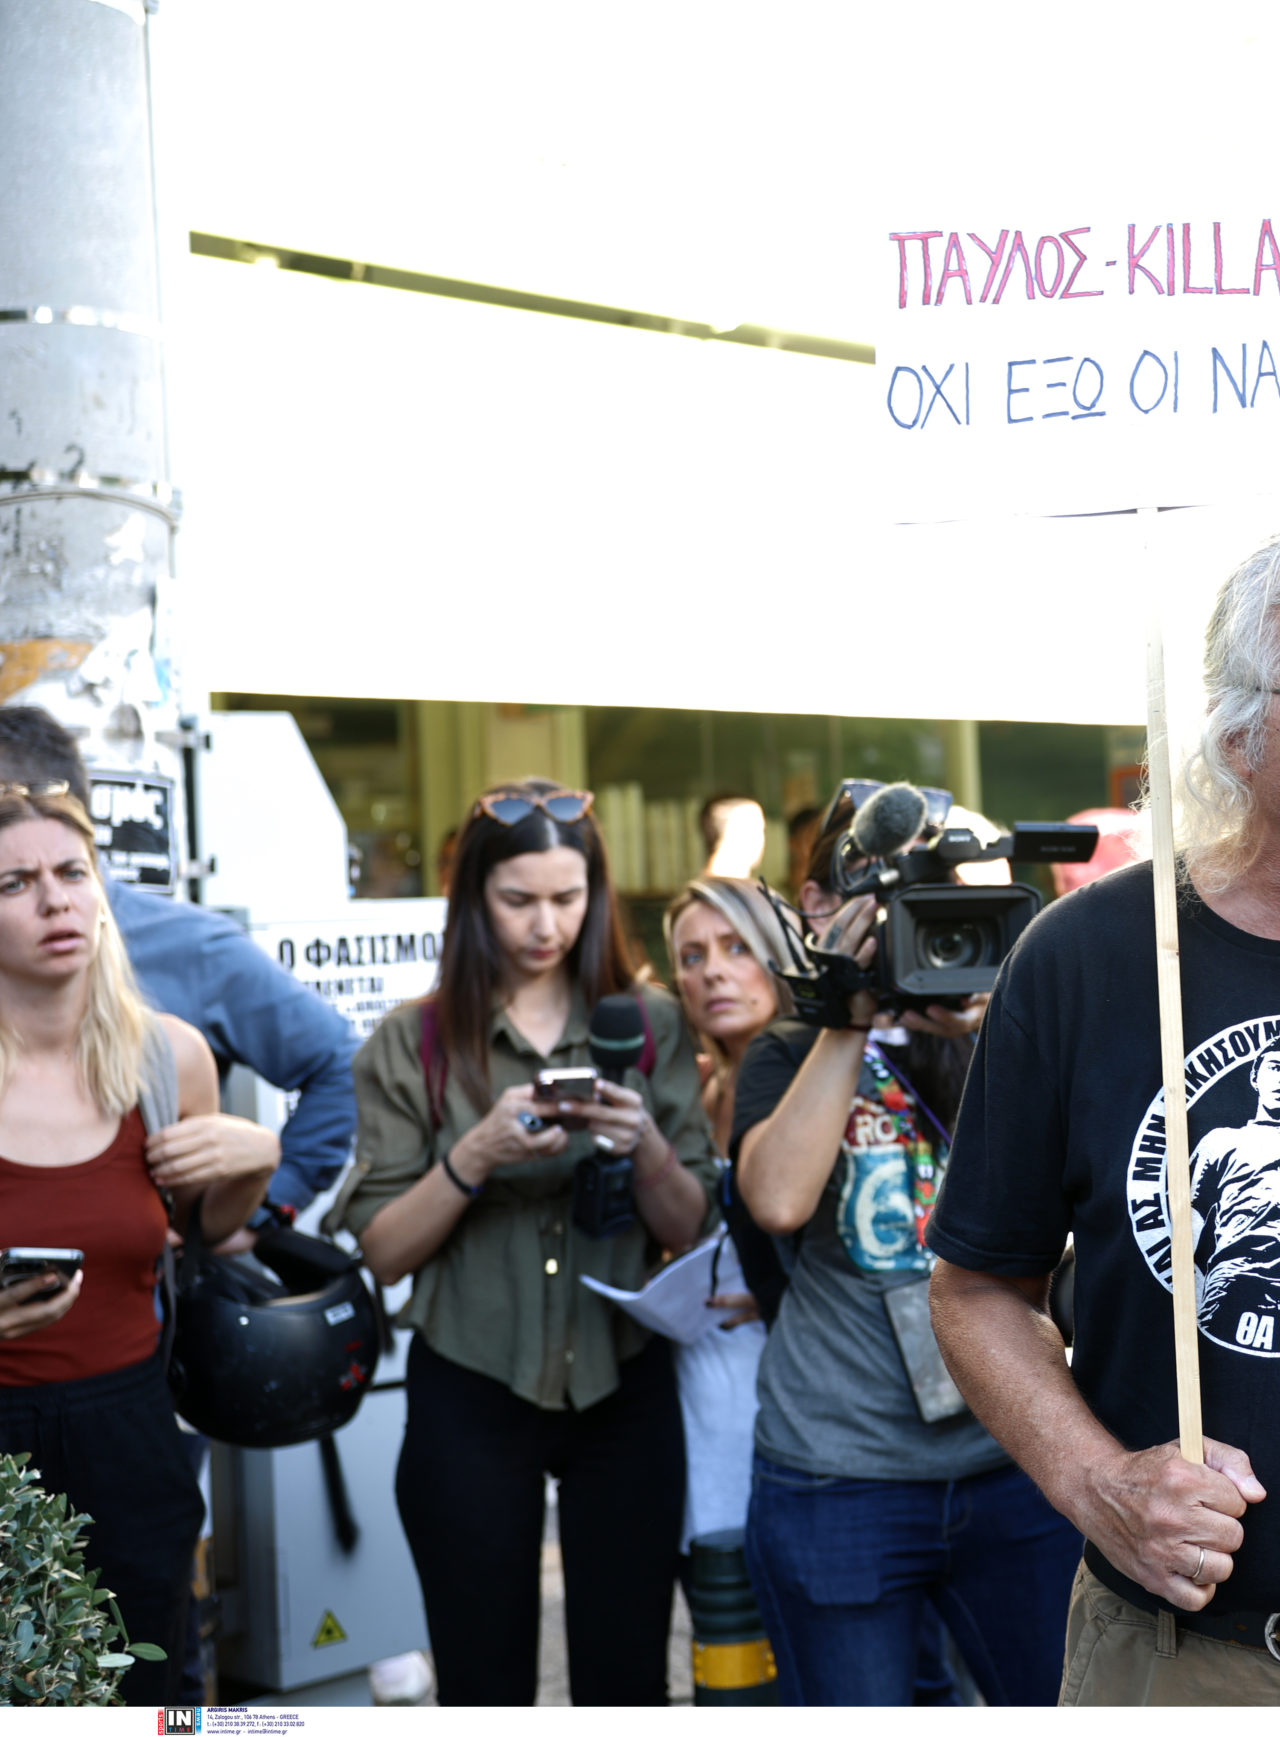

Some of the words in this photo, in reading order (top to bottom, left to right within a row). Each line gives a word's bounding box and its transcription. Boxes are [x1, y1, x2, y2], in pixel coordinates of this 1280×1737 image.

[887, 361, 970, 430] ΟΧΙ
[1128, 349, 1179, 415] ΟΙ
[306, 932, 445, 969] ΦΑΣΙΣΜΟ
[1131, 1192, 1166, 1233] ΑΣ
[1145, 1235, 1173, 1286] ΑΙ
[1235, 1311, 1275, 1350] ΘΑ
